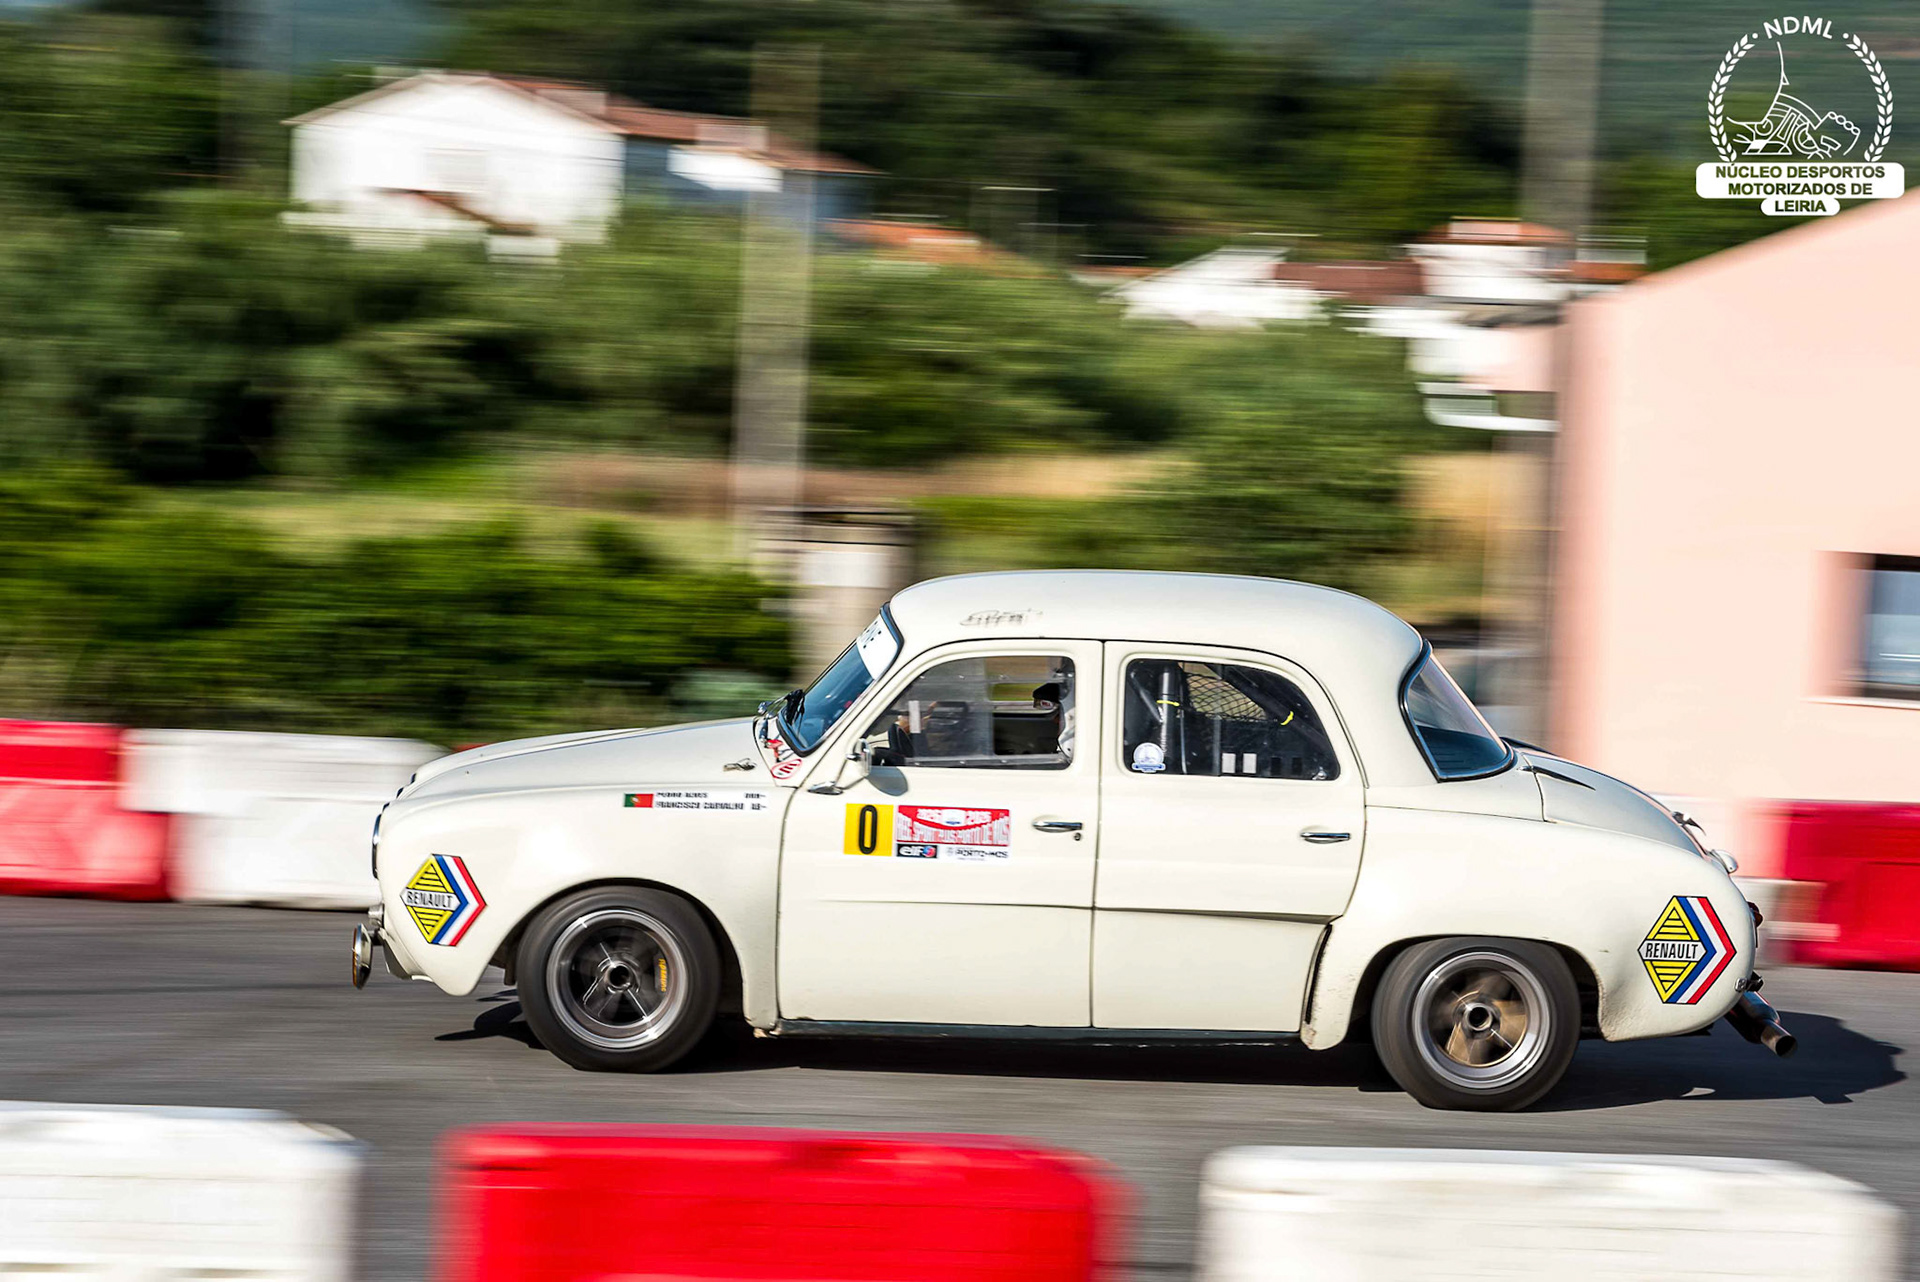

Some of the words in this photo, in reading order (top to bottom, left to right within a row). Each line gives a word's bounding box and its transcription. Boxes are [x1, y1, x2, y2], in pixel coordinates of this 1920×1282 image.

[858, 804, 878, 855] 0
[406, 890, 453, 908] RENAULT
[1645, 942, 1699, 960] RENAULT
